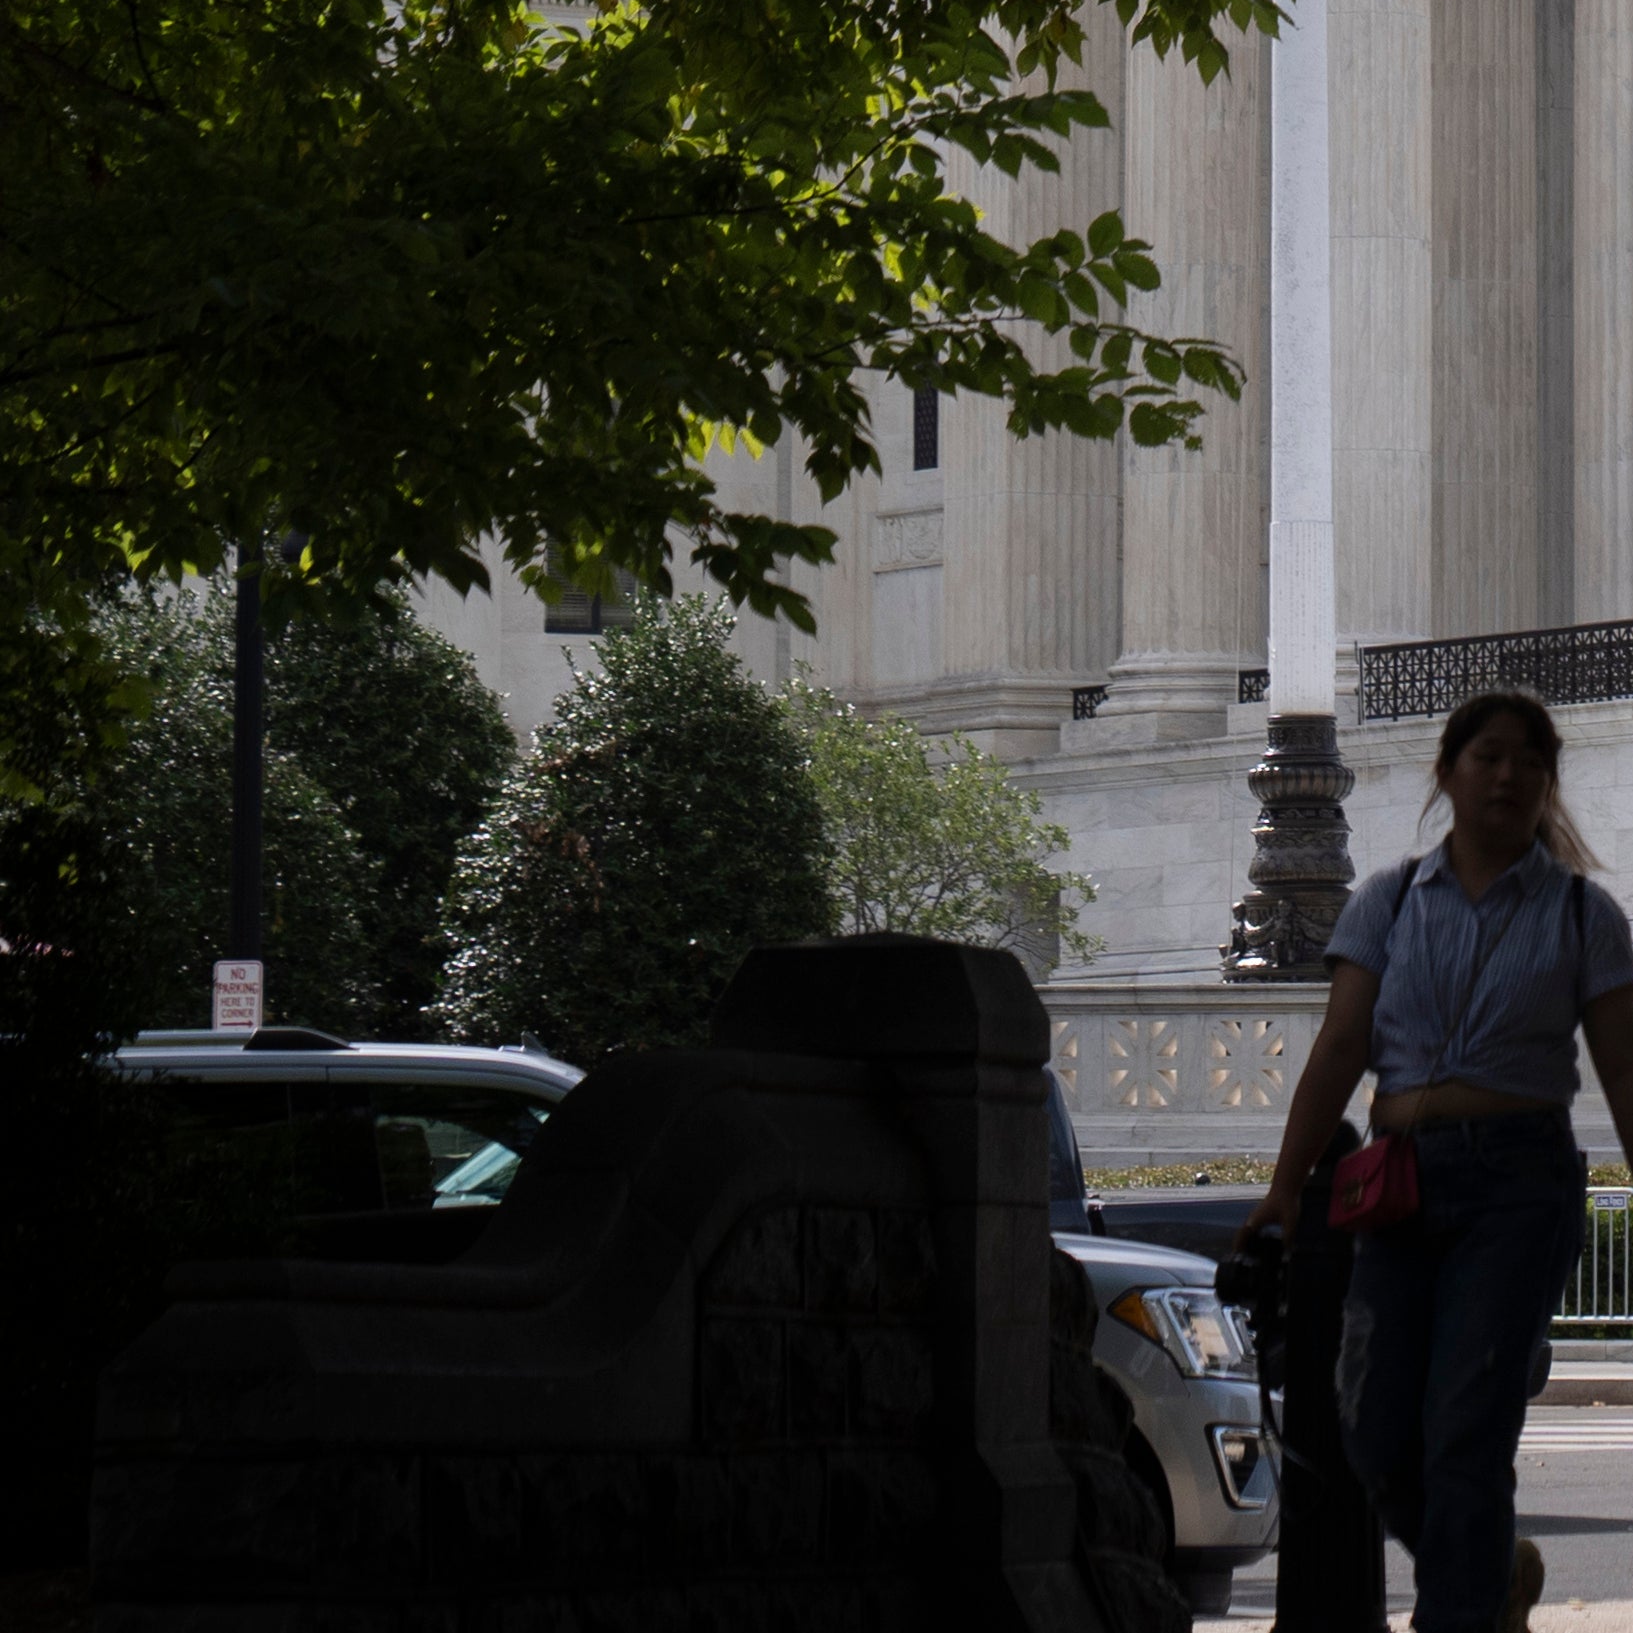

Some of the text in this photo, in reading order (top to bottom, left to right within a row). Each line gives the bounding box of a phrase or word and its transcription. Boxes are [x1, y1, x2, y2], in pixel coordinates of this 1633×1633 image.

[231, 969, 246, 980] NO
[216, 982, 259, 995] PARKING
[221, 996, 255, 1007] HERE TO
[222, 1009, 253, 1018] CORNER
